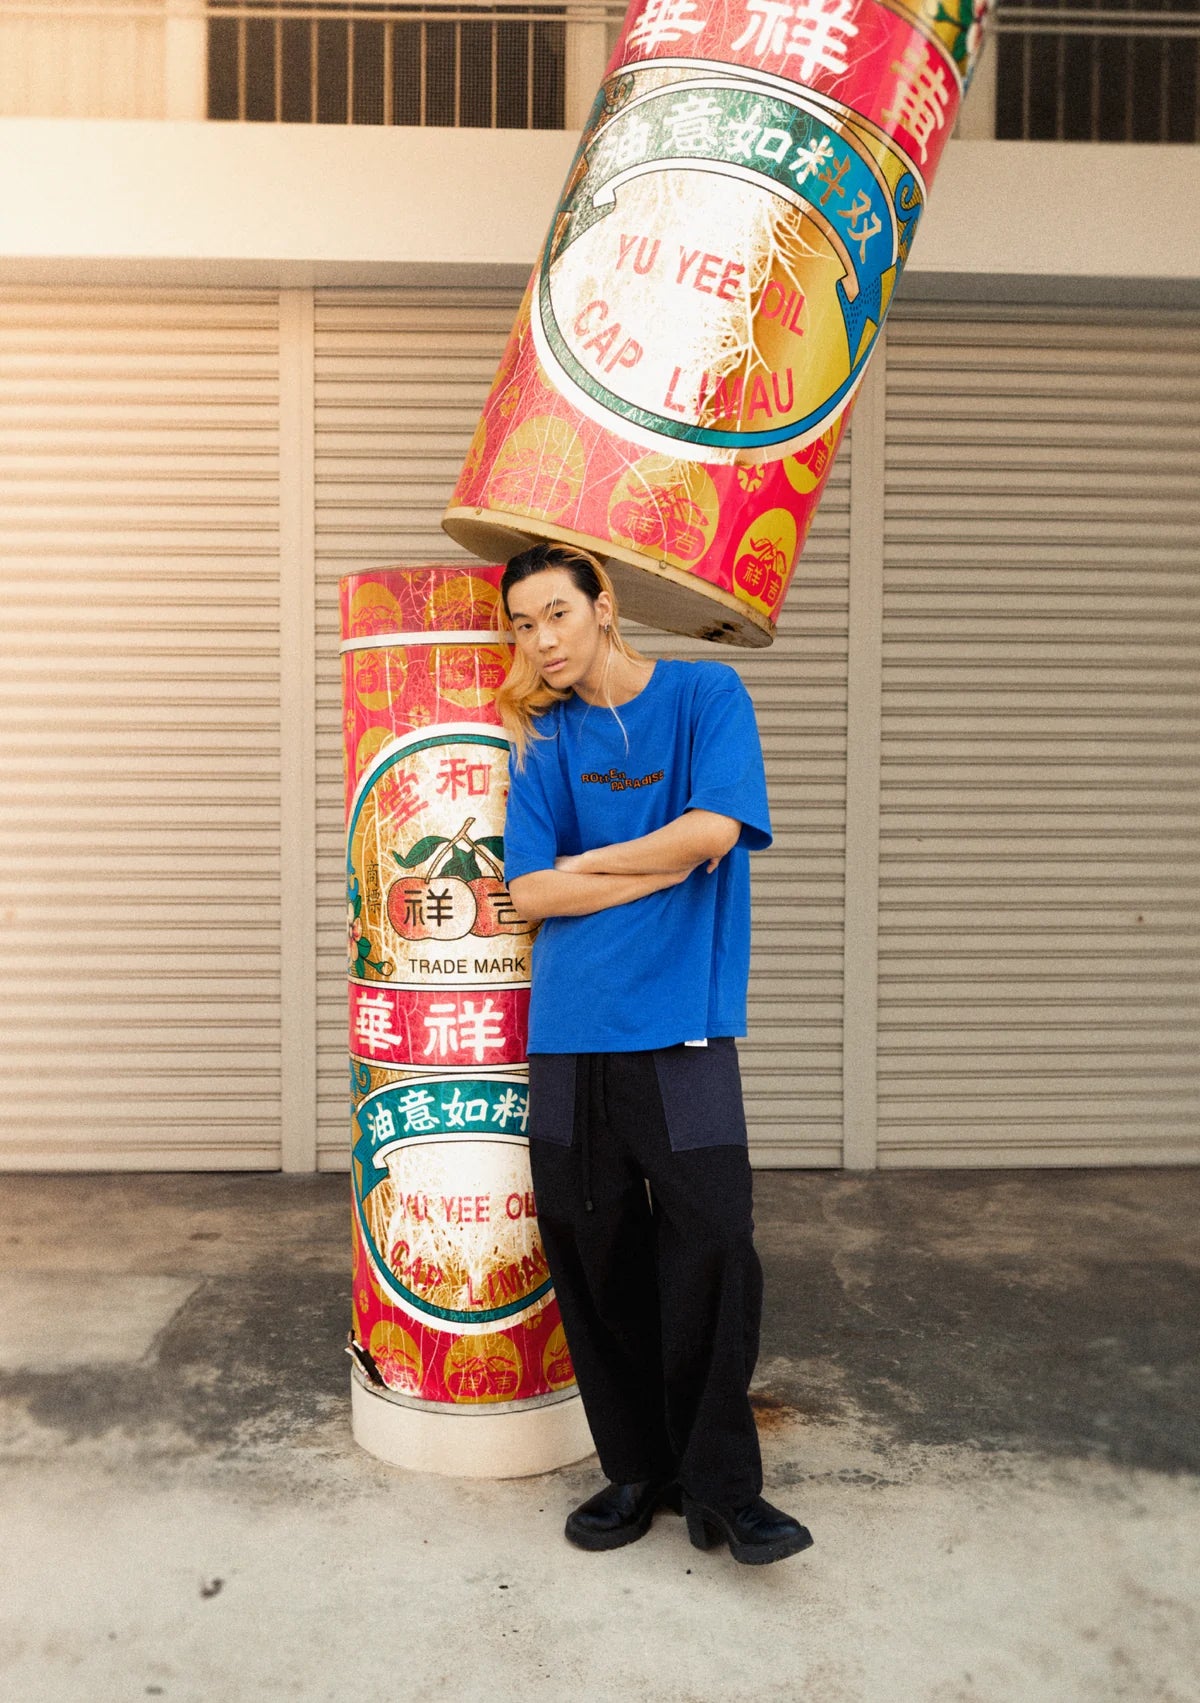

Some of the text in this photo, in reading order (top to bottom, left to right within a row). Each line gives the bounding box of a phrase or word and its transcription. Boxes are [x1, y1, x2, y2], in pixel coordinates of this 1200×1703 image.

[616, 233, 805, 337] YU YEE OIL
[574, 300, 794, 421] CAP LIMAU
[409, 957, 525, 974] TRADE MARK
[400, 1191, 428, 1221] YU
[441, 1195, 490, 1223] YEE
[390, 1239, 443, 1292] CAP
